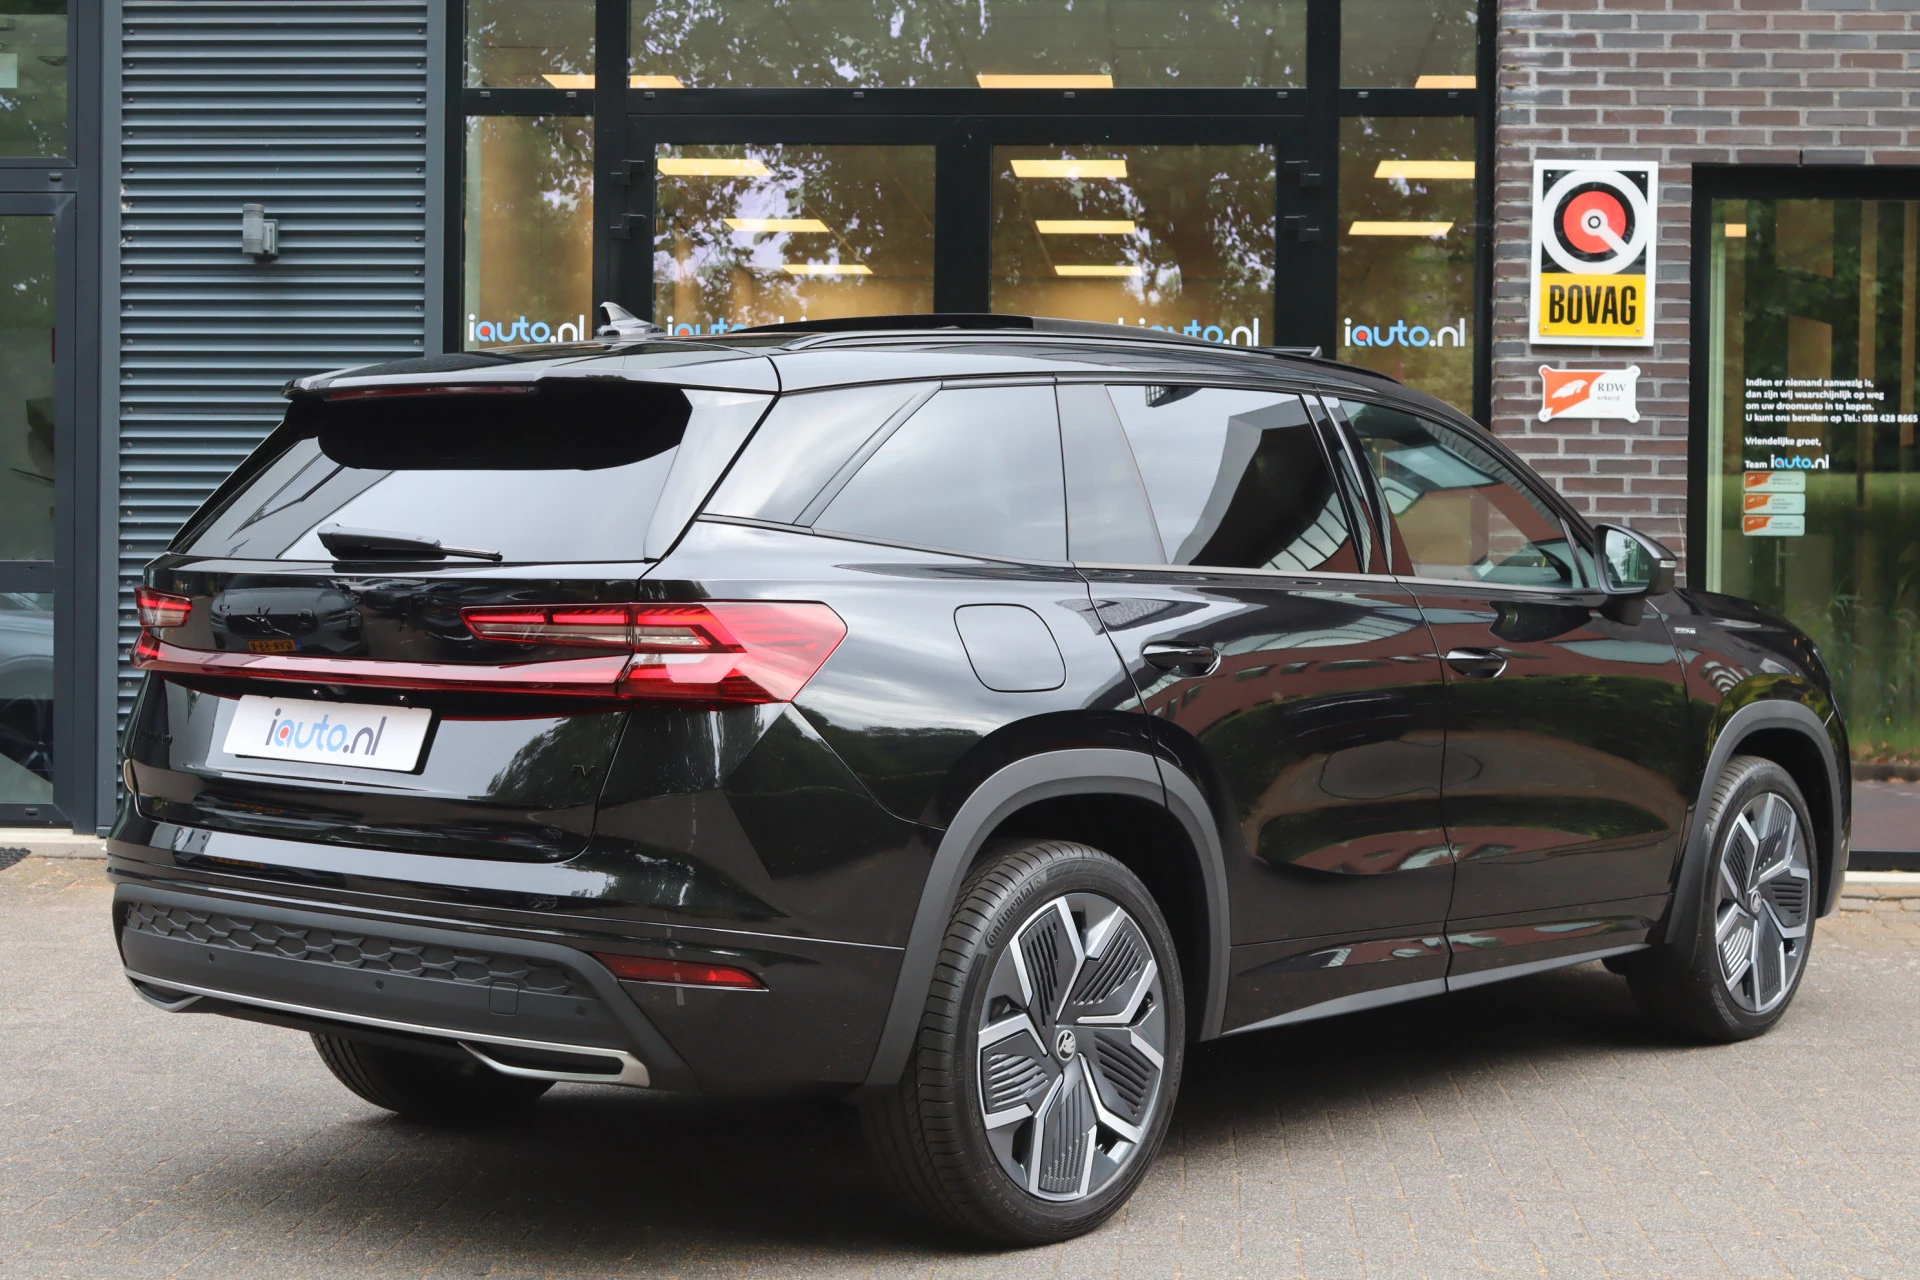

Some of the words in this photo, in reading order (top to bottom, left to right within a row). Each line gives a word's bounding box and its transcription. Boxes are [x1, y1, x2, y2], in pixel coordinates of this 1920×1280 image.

[1549, 284, 1636, 325] BOVAG
[468, 313, 585, 343] iauto.nl
[1344, 317, 1466, 347] iauto.nl
[1598, 383, 1627, 392] RDW
[1746, 378, 1773, 387] Indien
[1785, 378, 1822, 387] niemand
[1823, 378, 1863, 389] aanwezig
[1864, 378, 1875, 389] is,
[1745, 390, 1762, 399] dan
[1763, 390, 1779, 400] zijn
[1780, 390, 1793, 400] wij
[1794, 390, 1852, 400] waarschijnlijk
[1853, 392, 1866, 401] op
[1866, 392, 1885, 401] weg
[1745, 403, 1760, 411] om
[1761, 403, 1775, 411] uw
[1776, 402, 1824, 411] droomauto
[1825, 402, 1834, 411] in
[1835, 403, 1845, 411] te
[1845, 402, 1874, 412] kopen.
[1745, 414, 1753, 422] U
[1754, 413, 1774, 422] kunt
[1774, 415, 1791, 423] ons
[1792, 413, 1829, 423] bereiken
[1830, 415, 1842, 424] op
[1843, 413, 1861, 423] Tel.:
[1862, 414, 1879, 423] 088
[1879, 414, 1896, 423] 428
[1897, 414, 1919, 423] 8665
[1745, 437, 1795, 447] Vriendelijke
[1796, 438, 1822, 448] groet,
[1745, 460, 1768, 469] Team
[1770, 454, 1830, 470] iauto.nl
[264, 707, 388, 756] iauto.nl
[985, 881, 1036, 949] Continental
